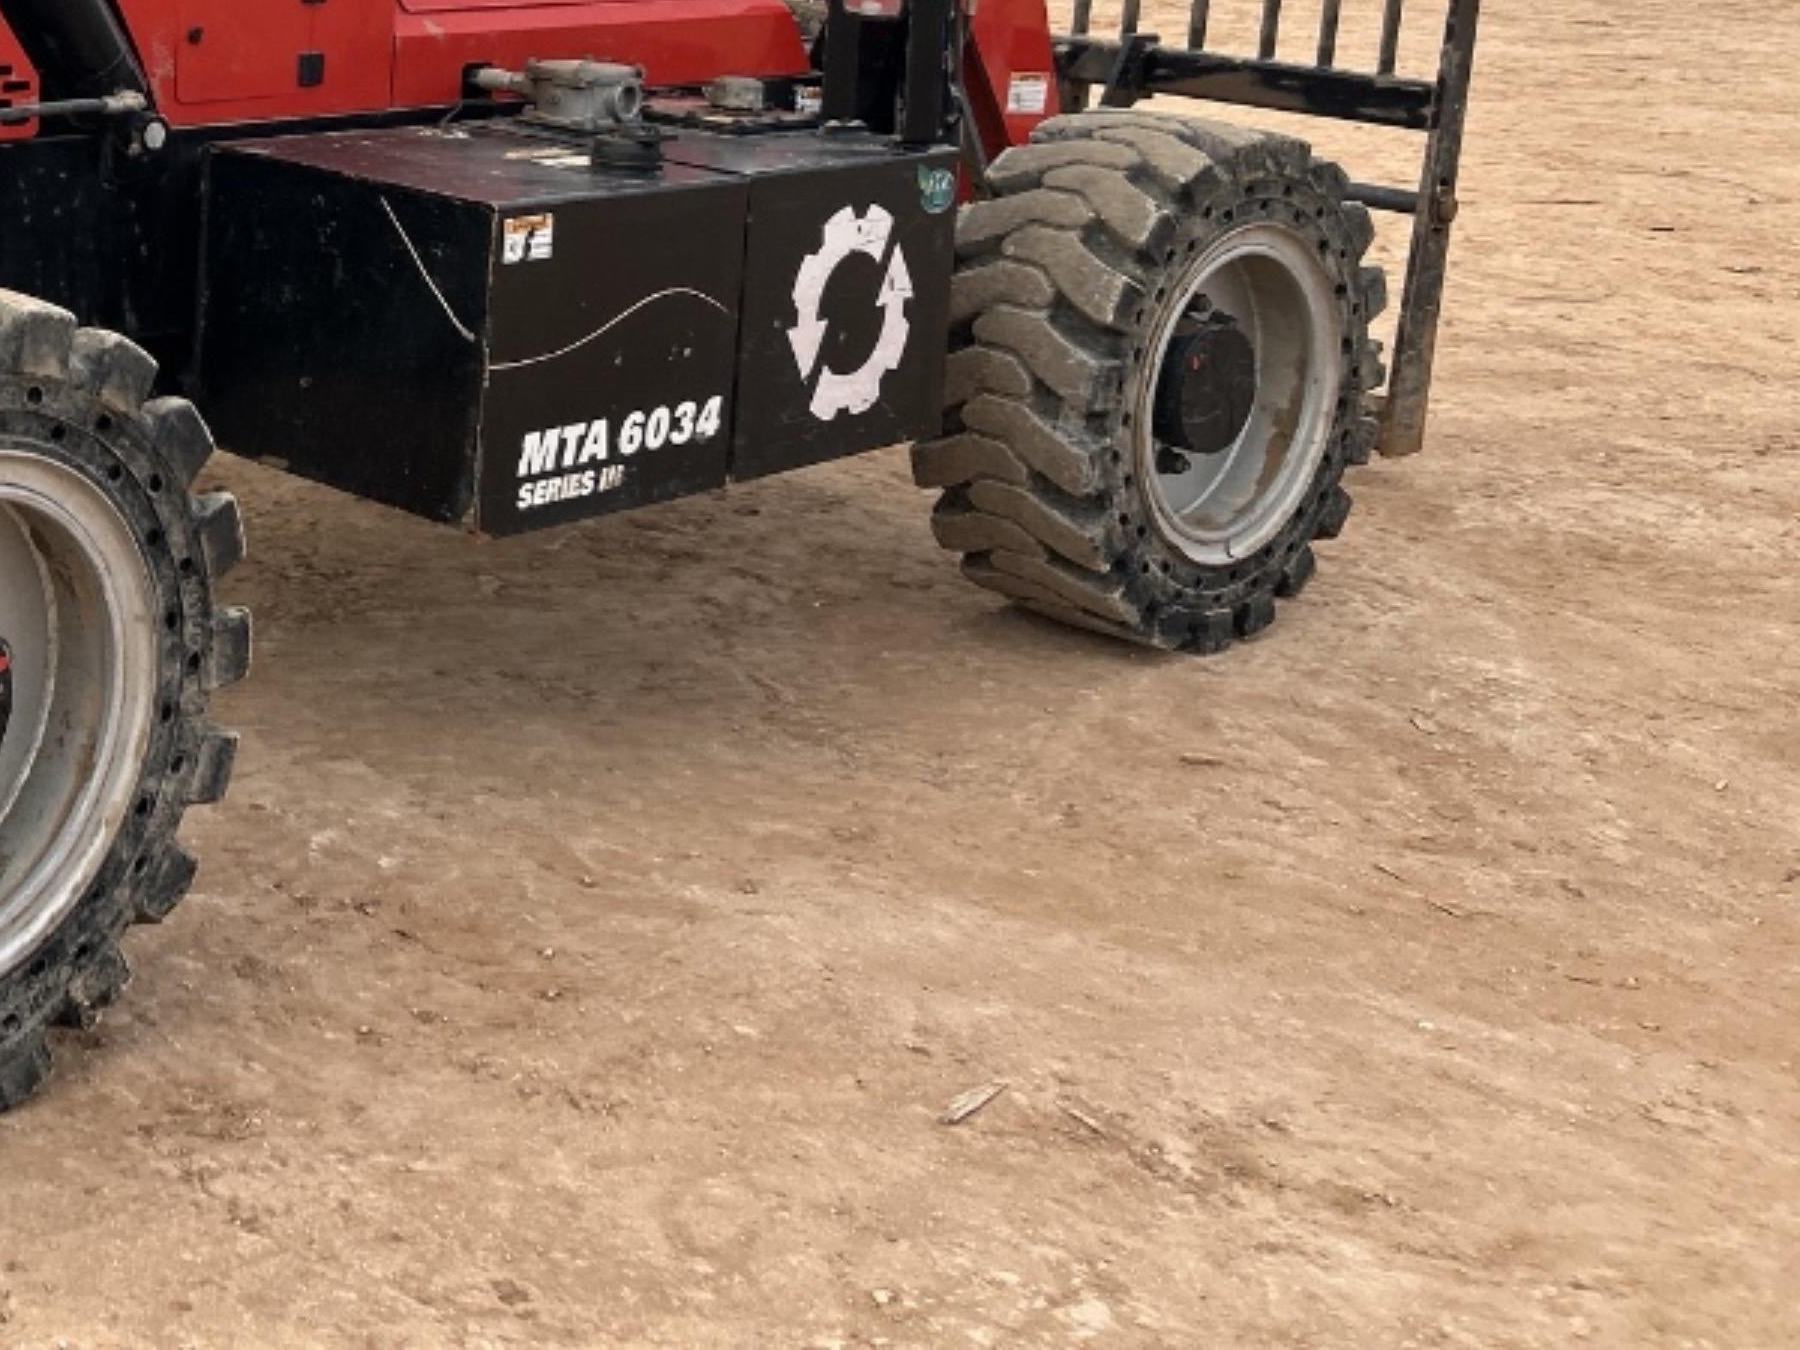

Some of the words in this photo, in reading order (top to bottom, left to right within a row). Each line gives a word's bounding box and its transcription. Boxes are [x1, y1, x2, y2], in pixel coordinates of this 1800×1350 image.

[516, 417, 609, 478] MTA
[618, 394, 723, 456] 6034
[516, 469, 596, 510] SERIES
